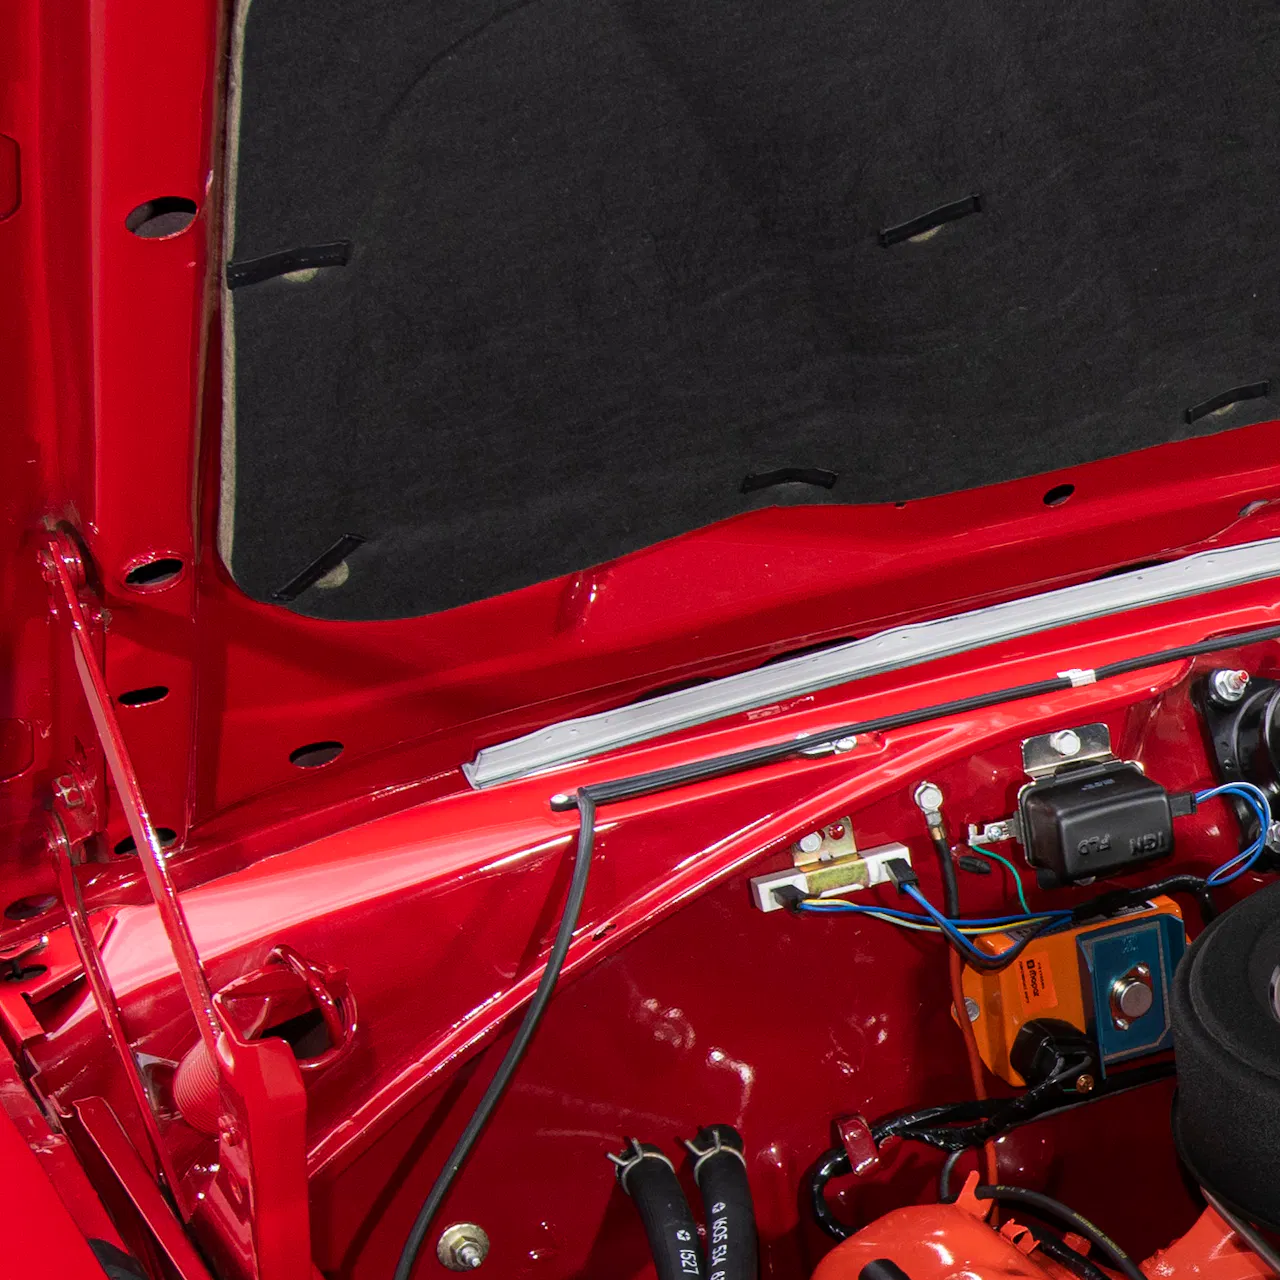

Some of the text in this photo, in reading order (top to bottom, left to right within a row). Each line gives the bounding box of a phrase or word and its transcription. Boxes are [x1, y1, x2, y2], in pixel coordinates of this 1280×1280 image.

[711, 1216, 728, 1243] 1605
[679, 1249, 699, 1275] 1527
[711, 1244, 727, 1266] 534
